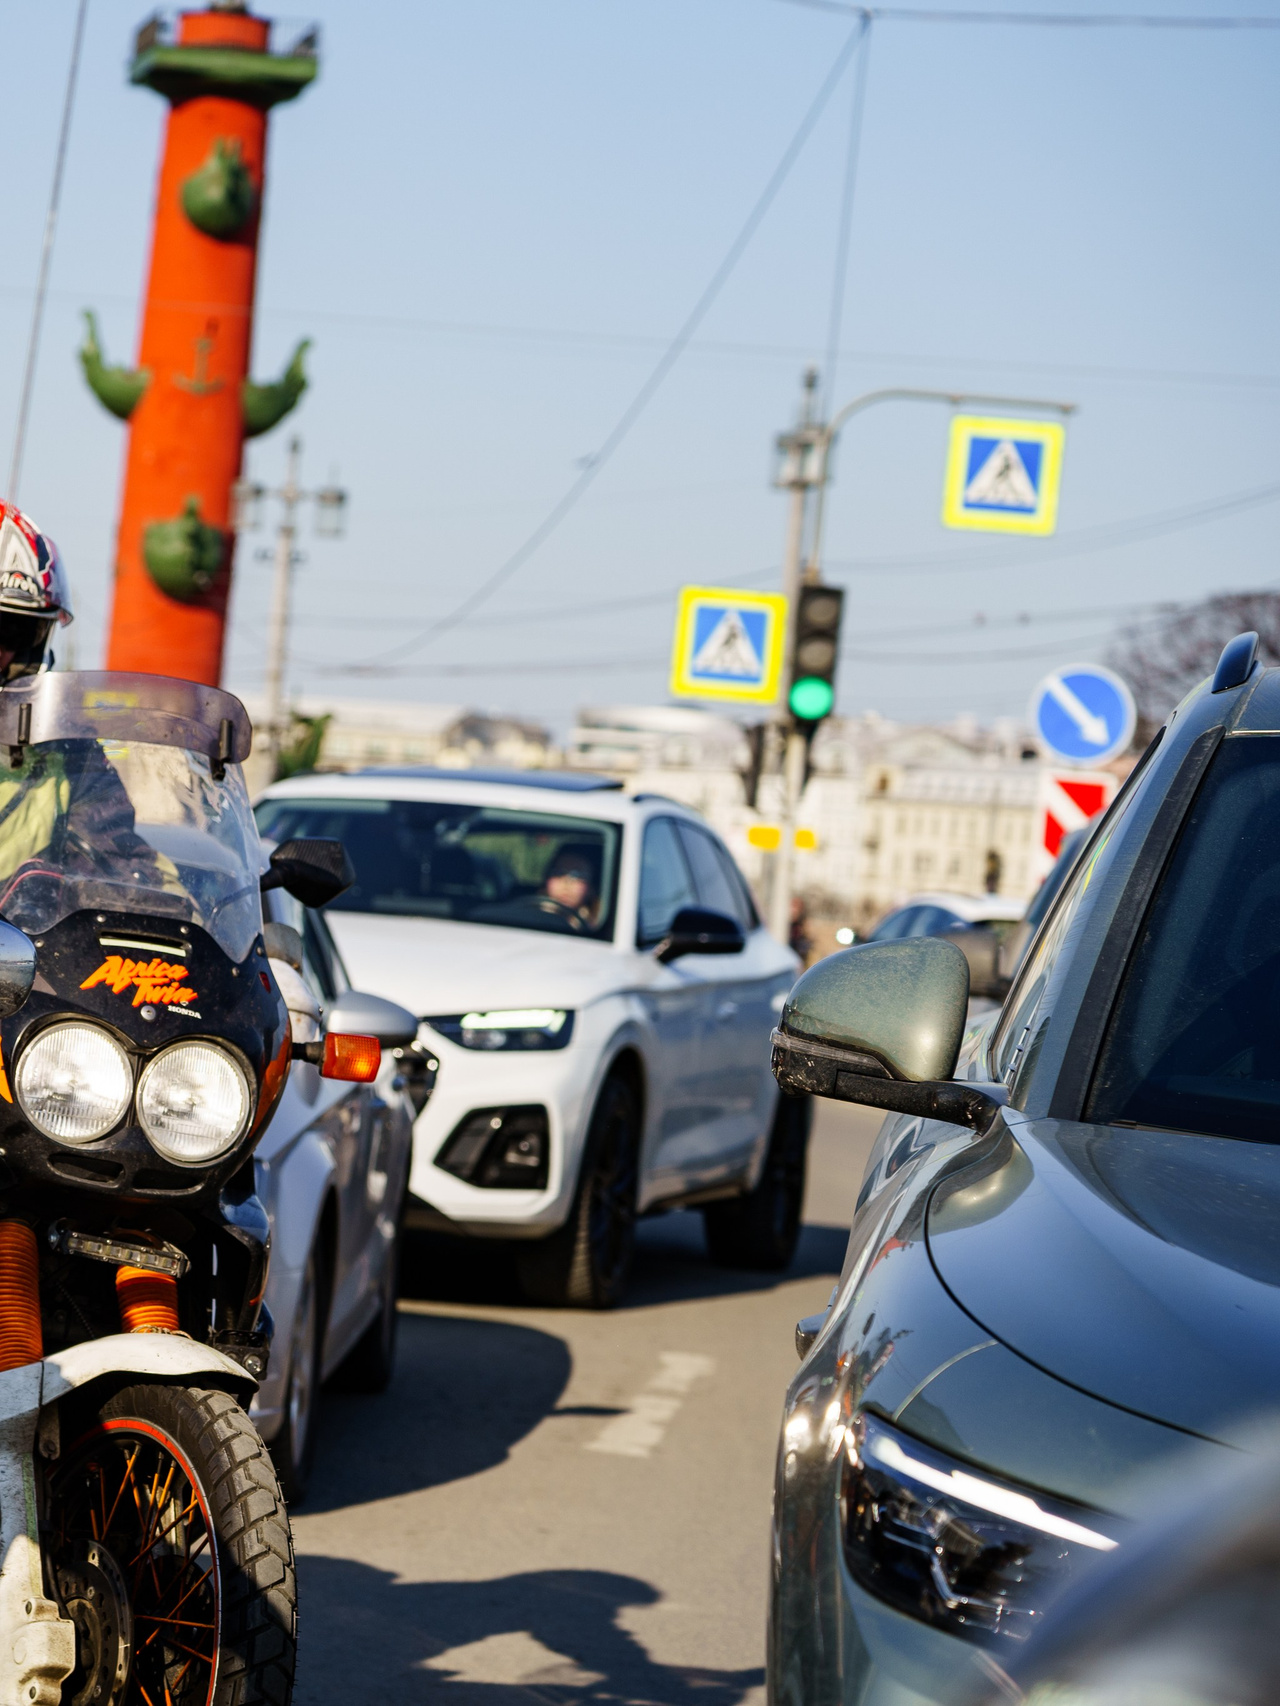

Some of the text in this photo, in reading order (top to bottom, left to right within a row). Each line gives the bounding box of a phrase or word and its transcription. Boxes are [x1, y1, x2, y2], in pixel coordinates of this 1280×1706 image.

[80, 955, 189, 995] Africa
[131, 977, 199, 1008] Twin
[167, 1005, 202, 1019] HONDA
